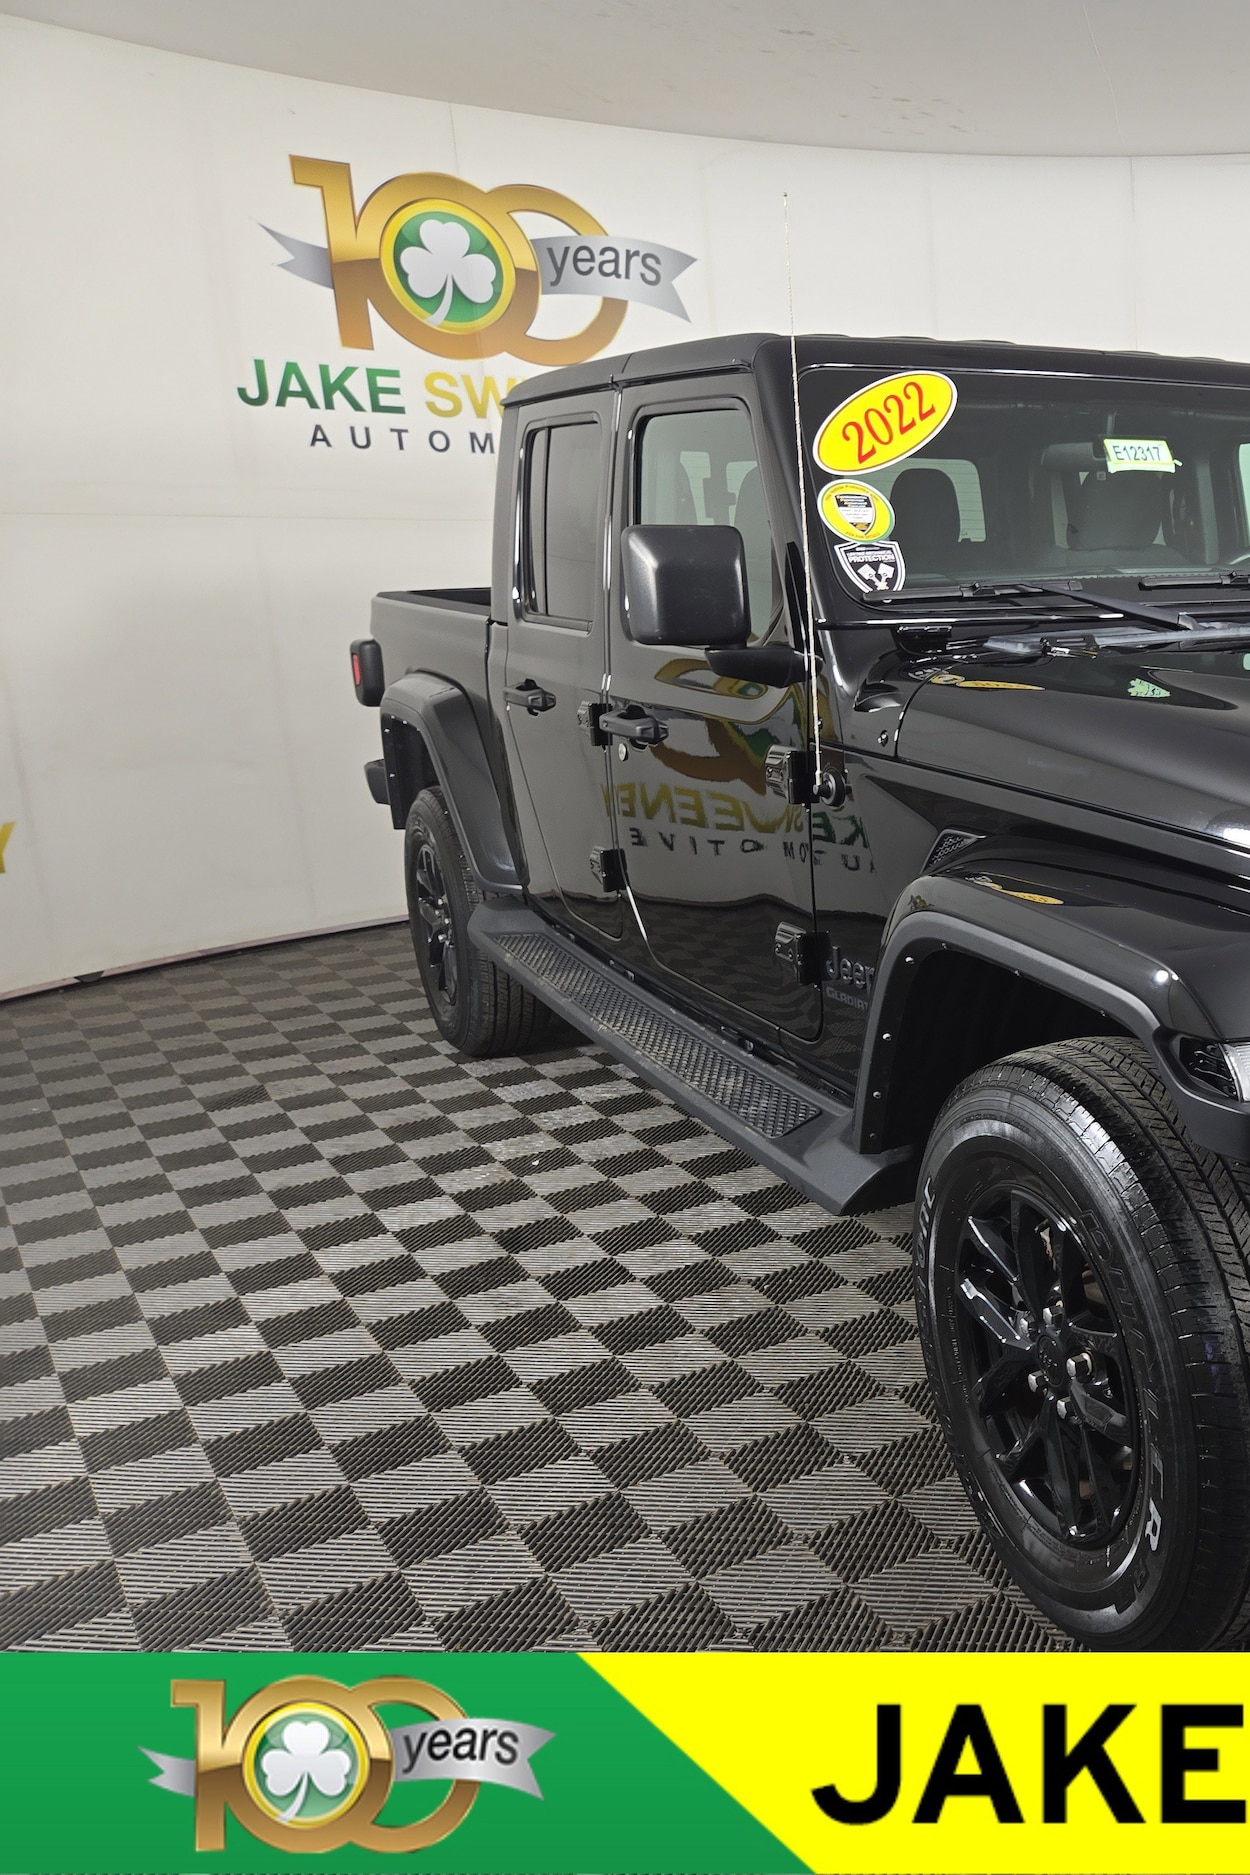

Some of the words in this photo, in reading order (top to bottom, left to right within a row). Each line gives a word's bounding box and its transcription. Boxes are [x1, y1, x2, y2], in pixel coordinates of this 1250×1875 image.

[289, 153, 628, 366] 100
[547, 243, 662, 288] years
[237, 358, 406, 415] JAKE
[841, 381, 936, 464] 2022
[1112, 445, 1161, 462] E12317
